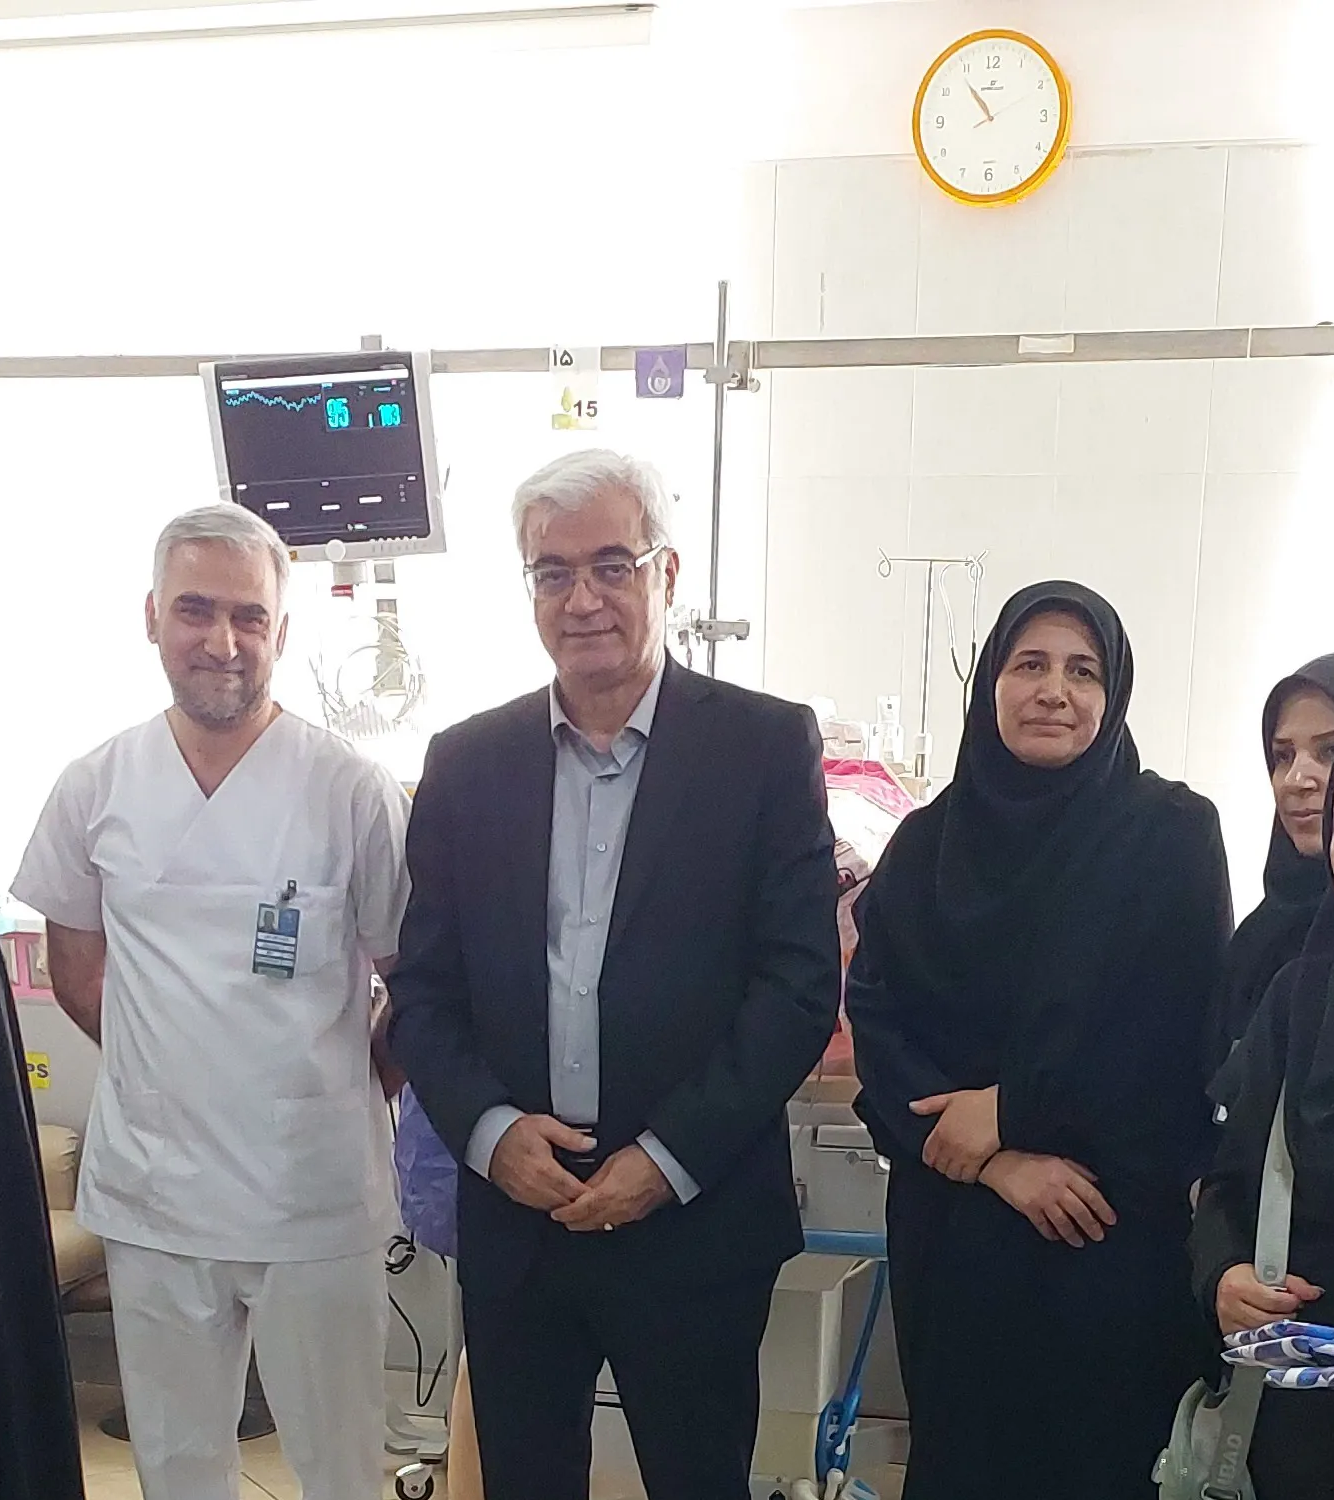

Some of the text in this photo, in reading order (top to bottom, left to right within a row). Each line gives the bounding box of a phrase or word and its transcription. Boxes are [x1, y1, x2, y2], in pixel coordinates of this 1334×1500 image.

[963, 63, 971, 73] 11
[986, 56, 1001, 69] 12
[1037, 80, 1044, 90] 2
[941, 87, 951, 97] 10
[935, 115, 945, 129] 9
[1039, 109, 1048, 122] 3
[1035, 141, 1042, 151] 4
[959, 167, 966, 178] 7
[983, 167, 993, 181] 6
[326, 397, 350, 428] 95
[573, 400, 598, 418] 15
